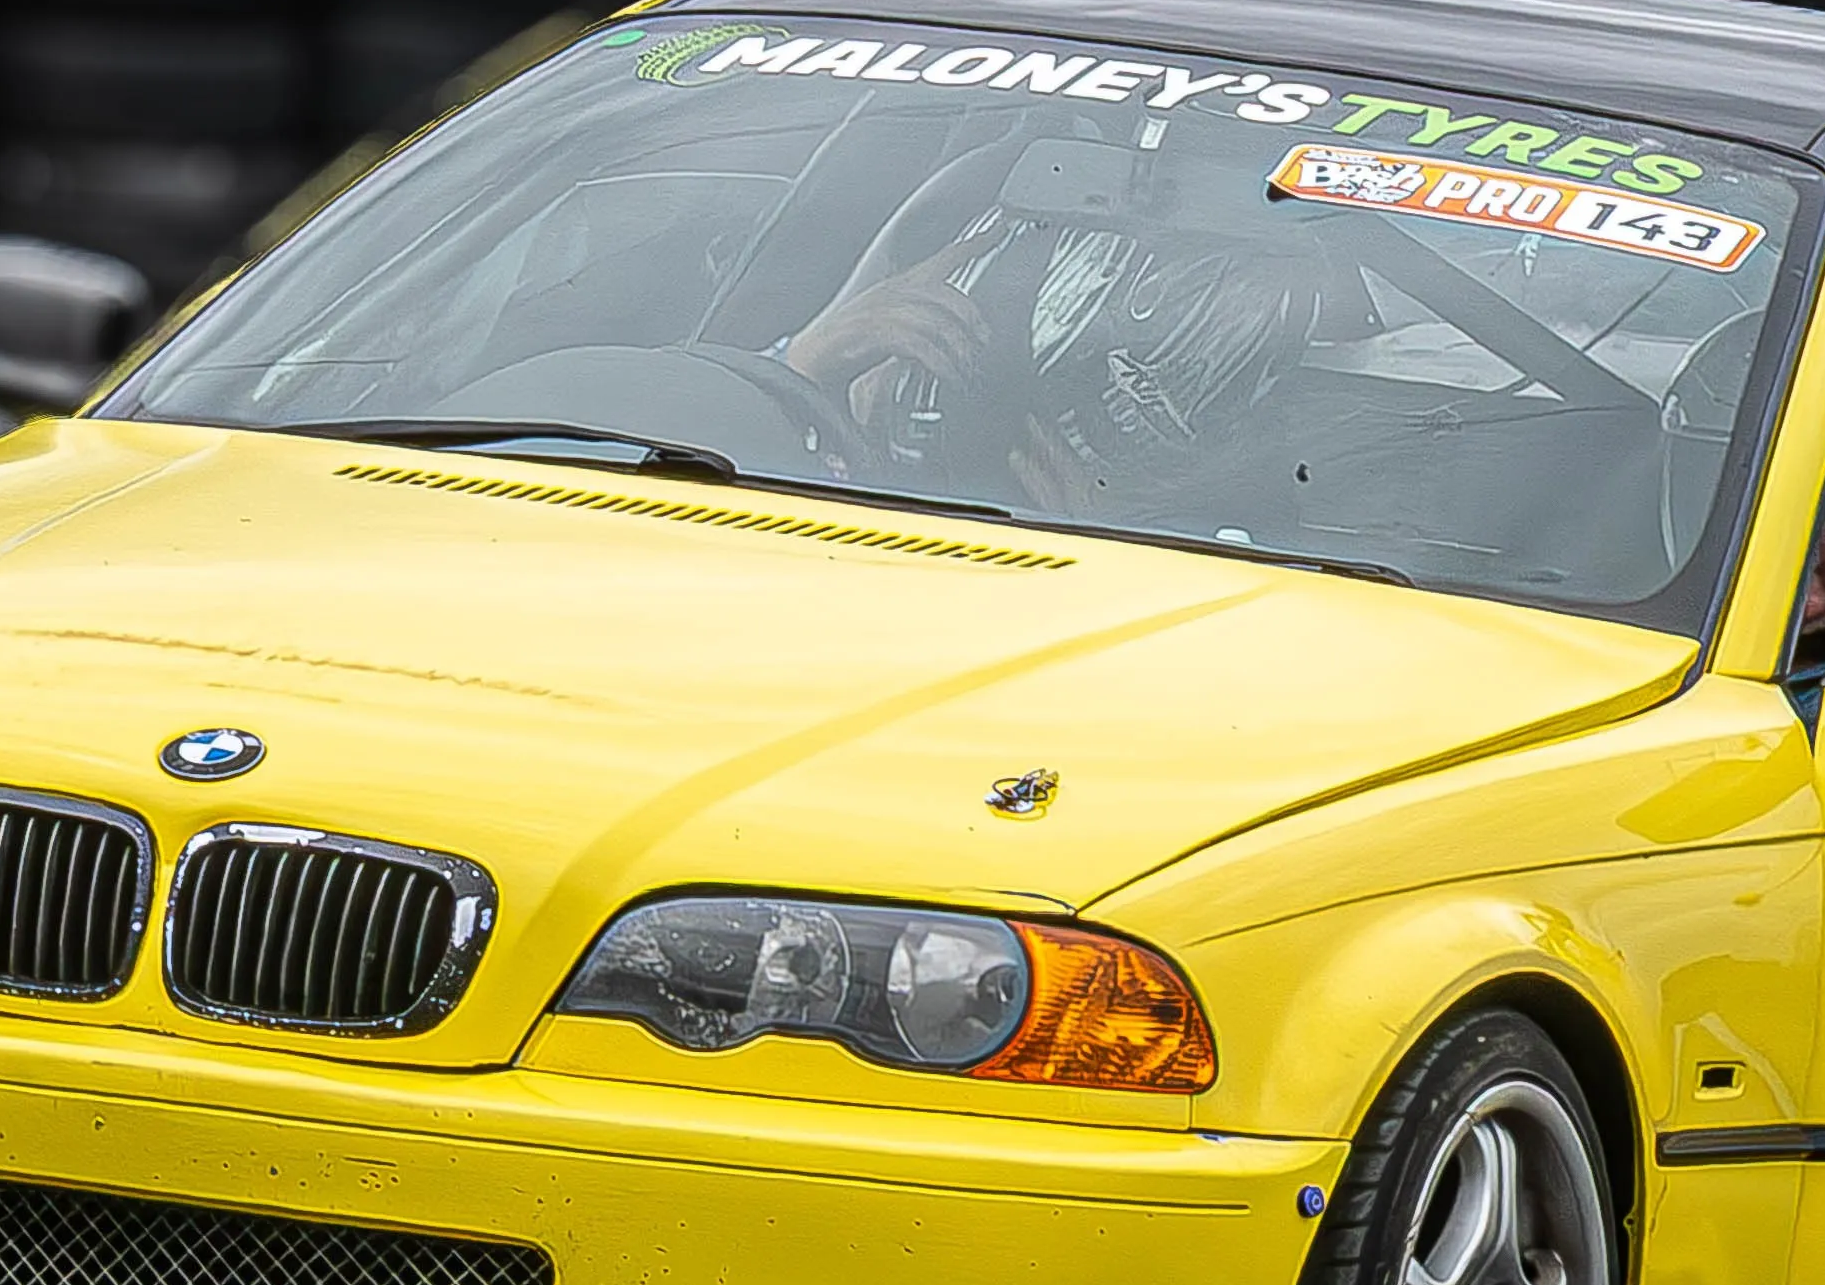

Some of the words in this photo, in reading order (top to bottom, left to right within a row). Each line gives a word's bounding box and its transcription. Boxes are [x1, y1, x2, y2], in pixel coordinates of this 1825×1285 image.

[698, 37, 1331, 124] MALONEY'S
[1332, 92, 1704, 195] TYRES
[1423, 171, 1564, 223] PRO
[1586, 201, 1722, 252] 143
